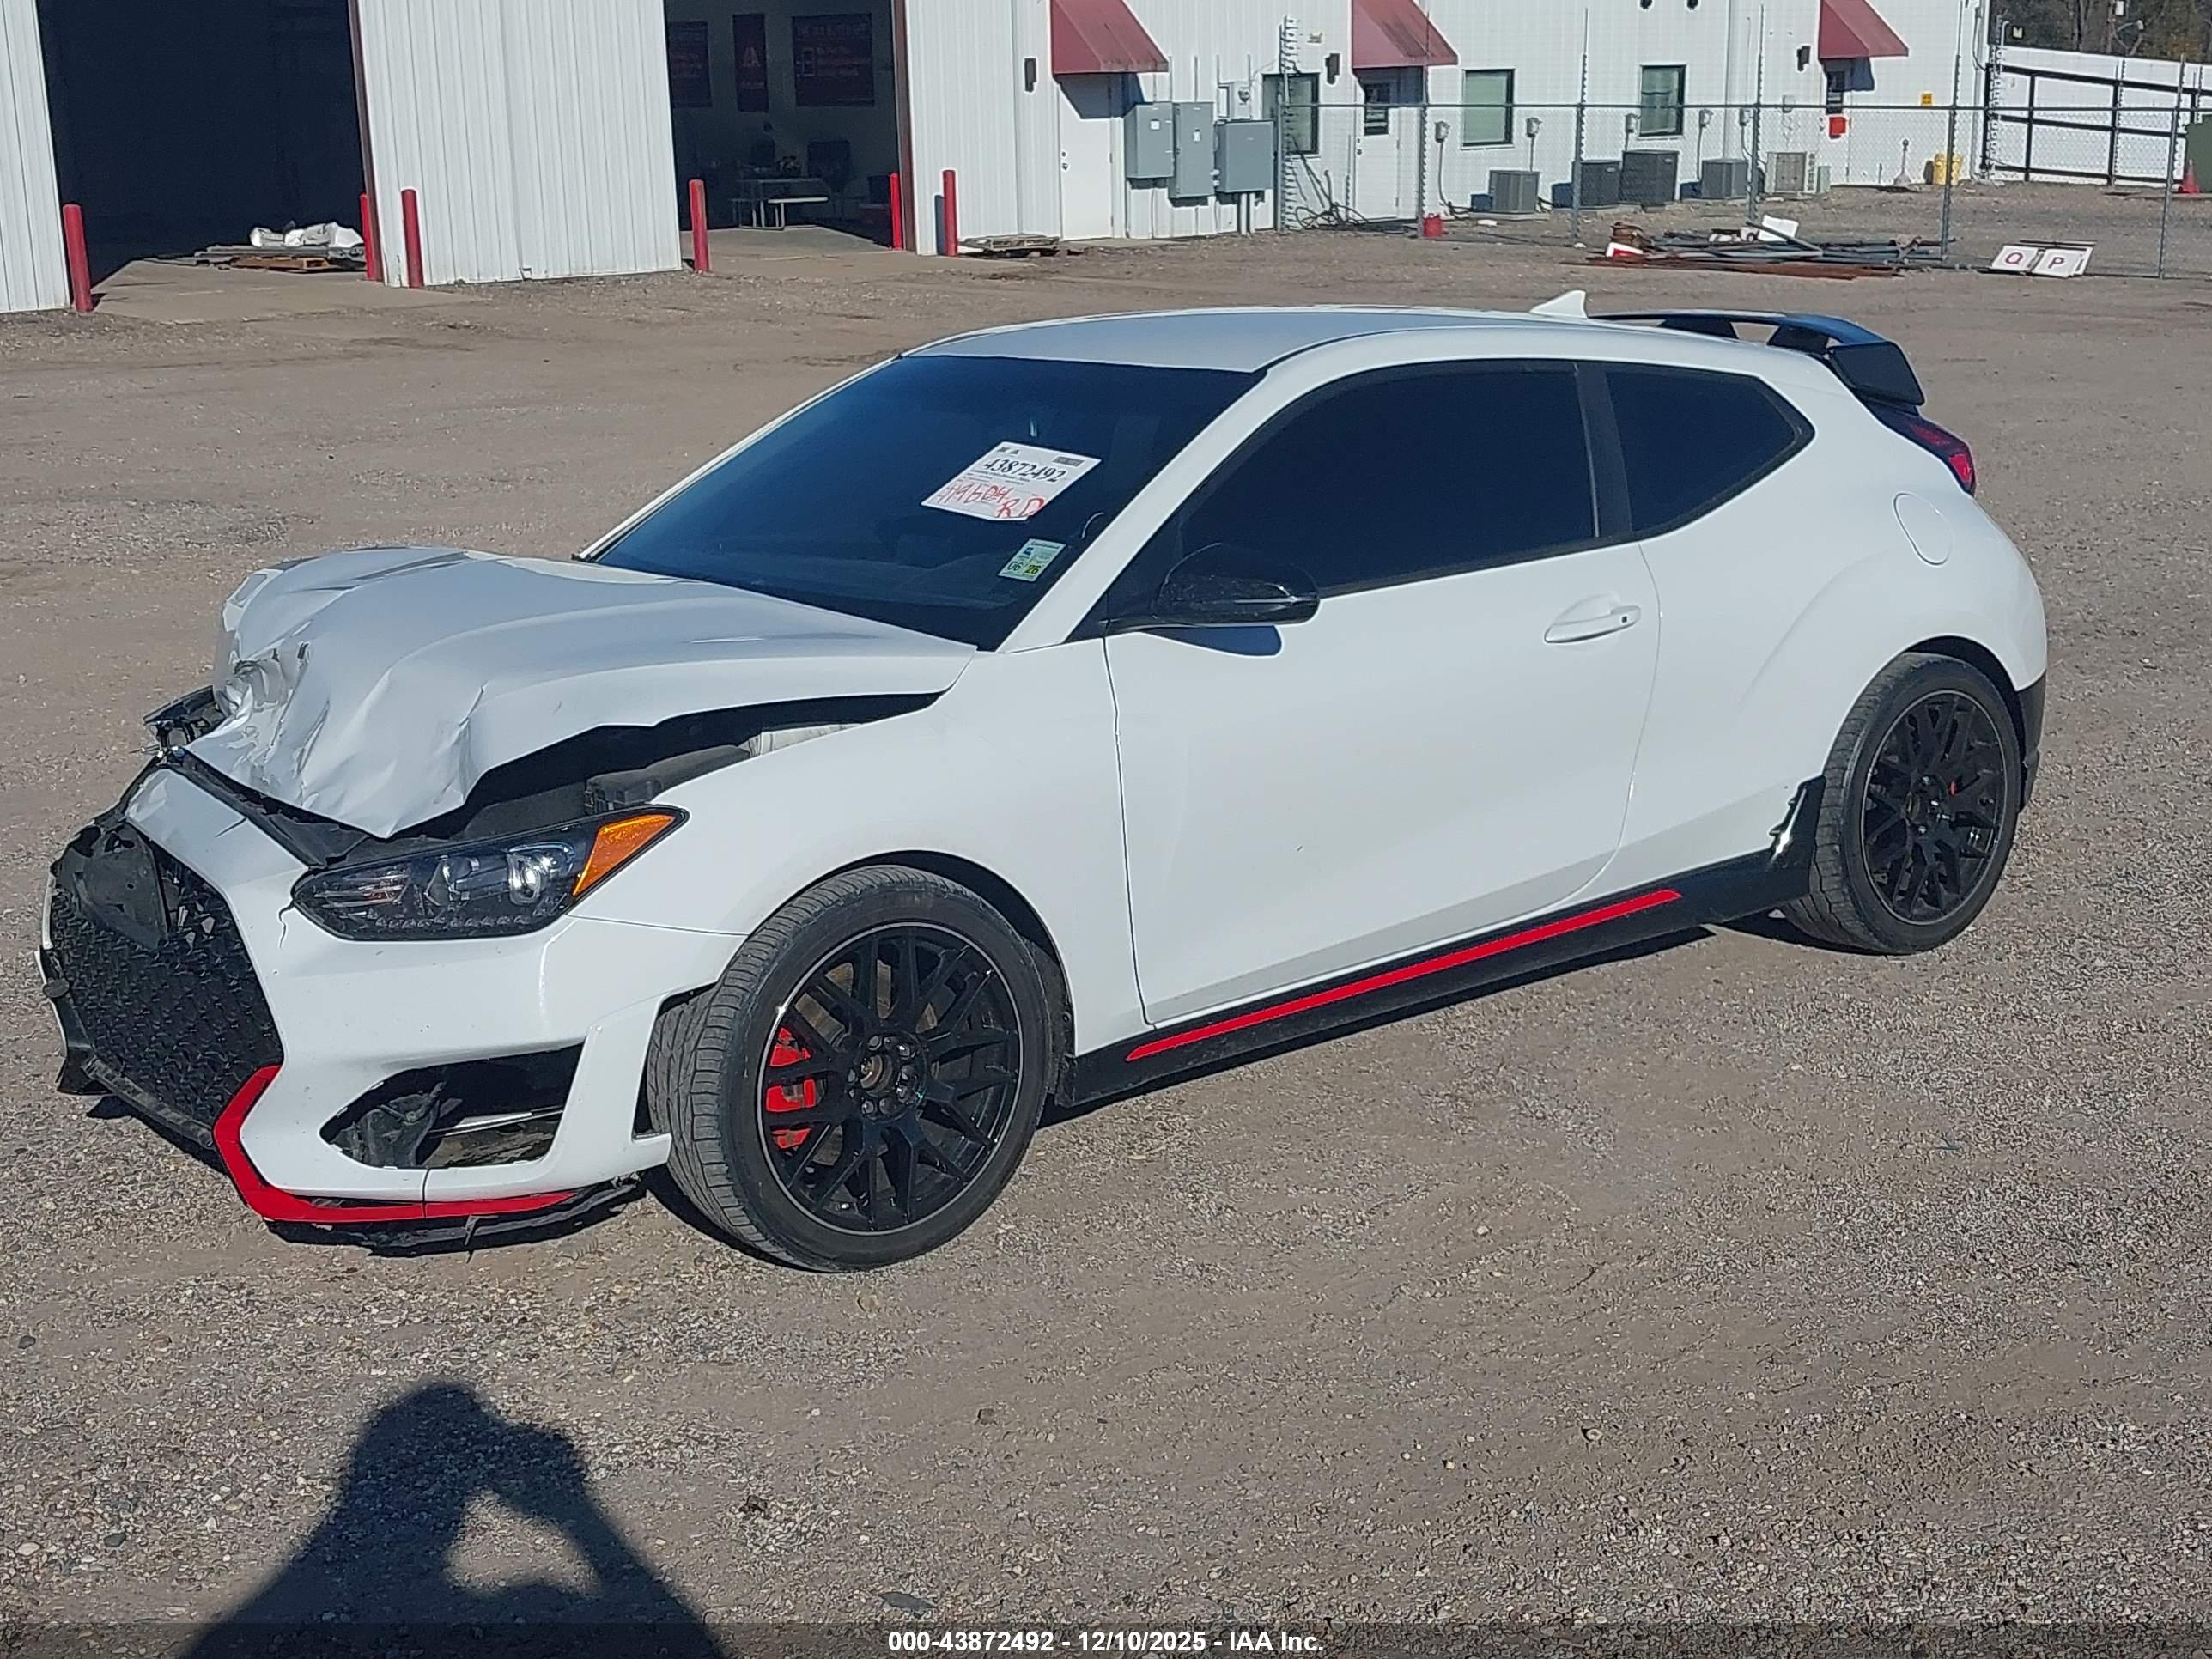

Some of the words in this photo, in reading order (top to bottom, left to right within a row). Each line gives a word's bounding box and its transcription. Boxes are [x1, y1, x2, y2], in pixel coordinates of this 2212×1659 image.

[2005, 252, 2023, 265] Q
[2047, 257, 2065, 269] P
[983, 458, 1066, 483] 43872492
[1024, 564, 1042, 574] 26
